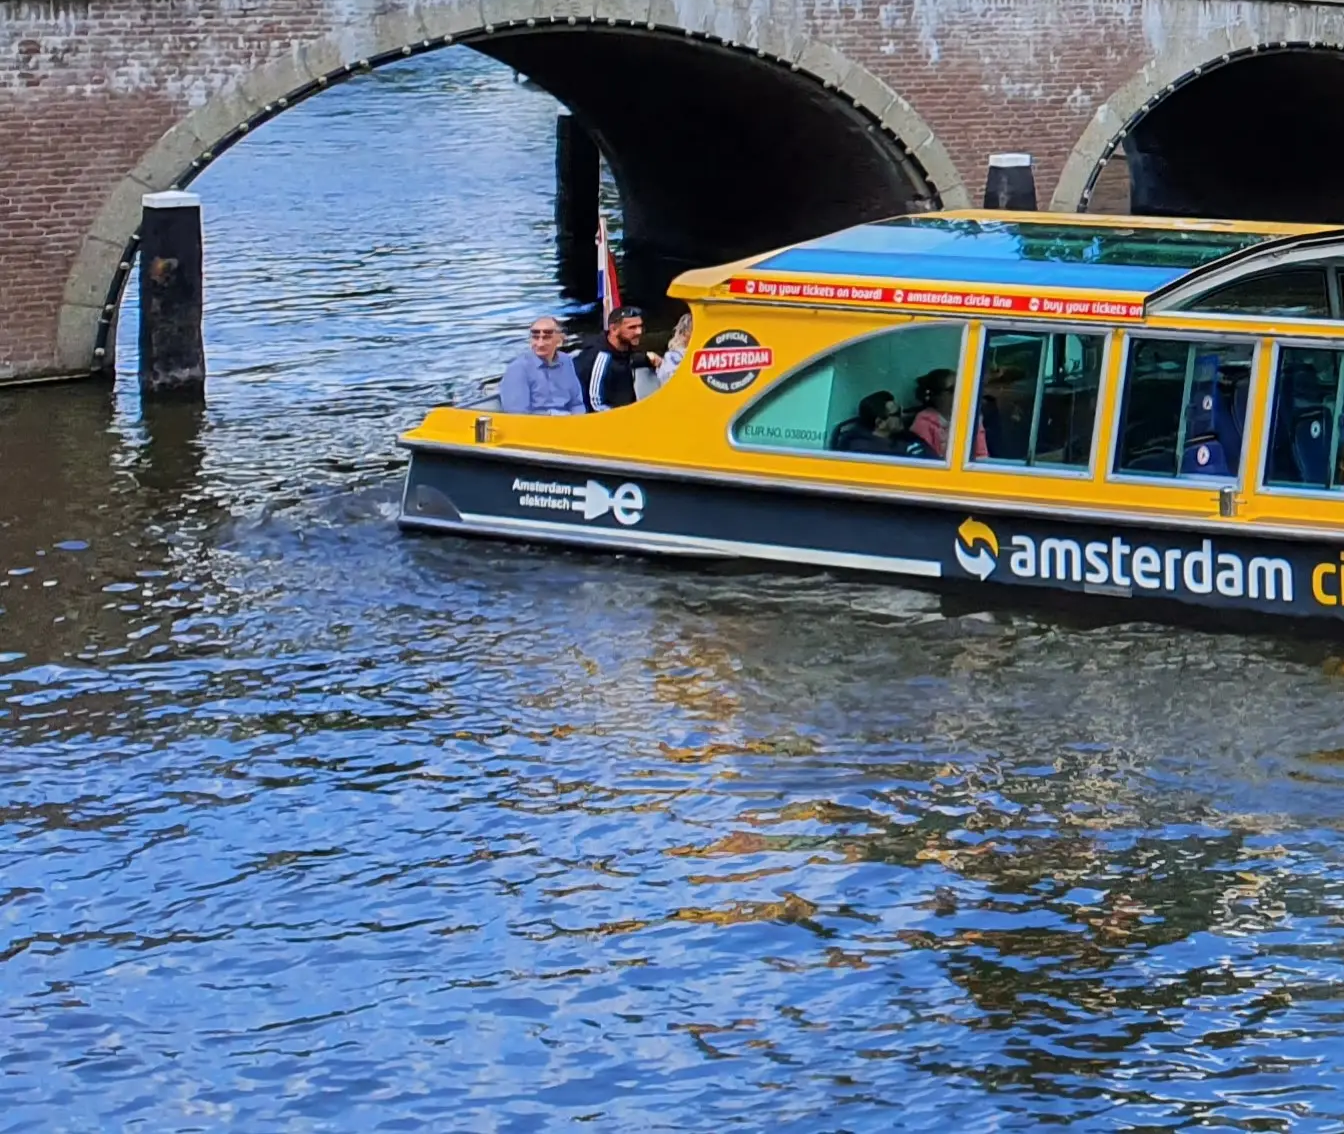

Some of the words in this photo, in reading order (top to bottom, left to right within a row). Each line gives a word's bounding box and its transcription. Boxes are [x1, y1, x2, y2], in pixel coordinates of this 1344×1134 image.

[758, 281, 777, 295] buy
[779, 284, 801, 296] your
[803, 283, 835, 298] tickets
[837, 288, 849, 298] on
[852, 287, 883, 300] board!
[907, 291, 962, 305] amsterdam
[964, 294, 990, 306] circle
[993, 294, 1013, 308] line
[1043, 298, 1063, 313] buy
[1066, 301, 1089, 314] your
[1092, 300, 1127, 315] tickets
[1129, 305, 1143, 316] on
[715, 331, 748, 344] OFFICIAL
[696, 351, 770, 370] AMSTERDAM
[706, 374, 730, 391] CANAL
[512, 477, 572, 496] Amsterdam
[519, 494, 570, 511] elektrisch
[1010, 534, 1293, 602] amsterdam
